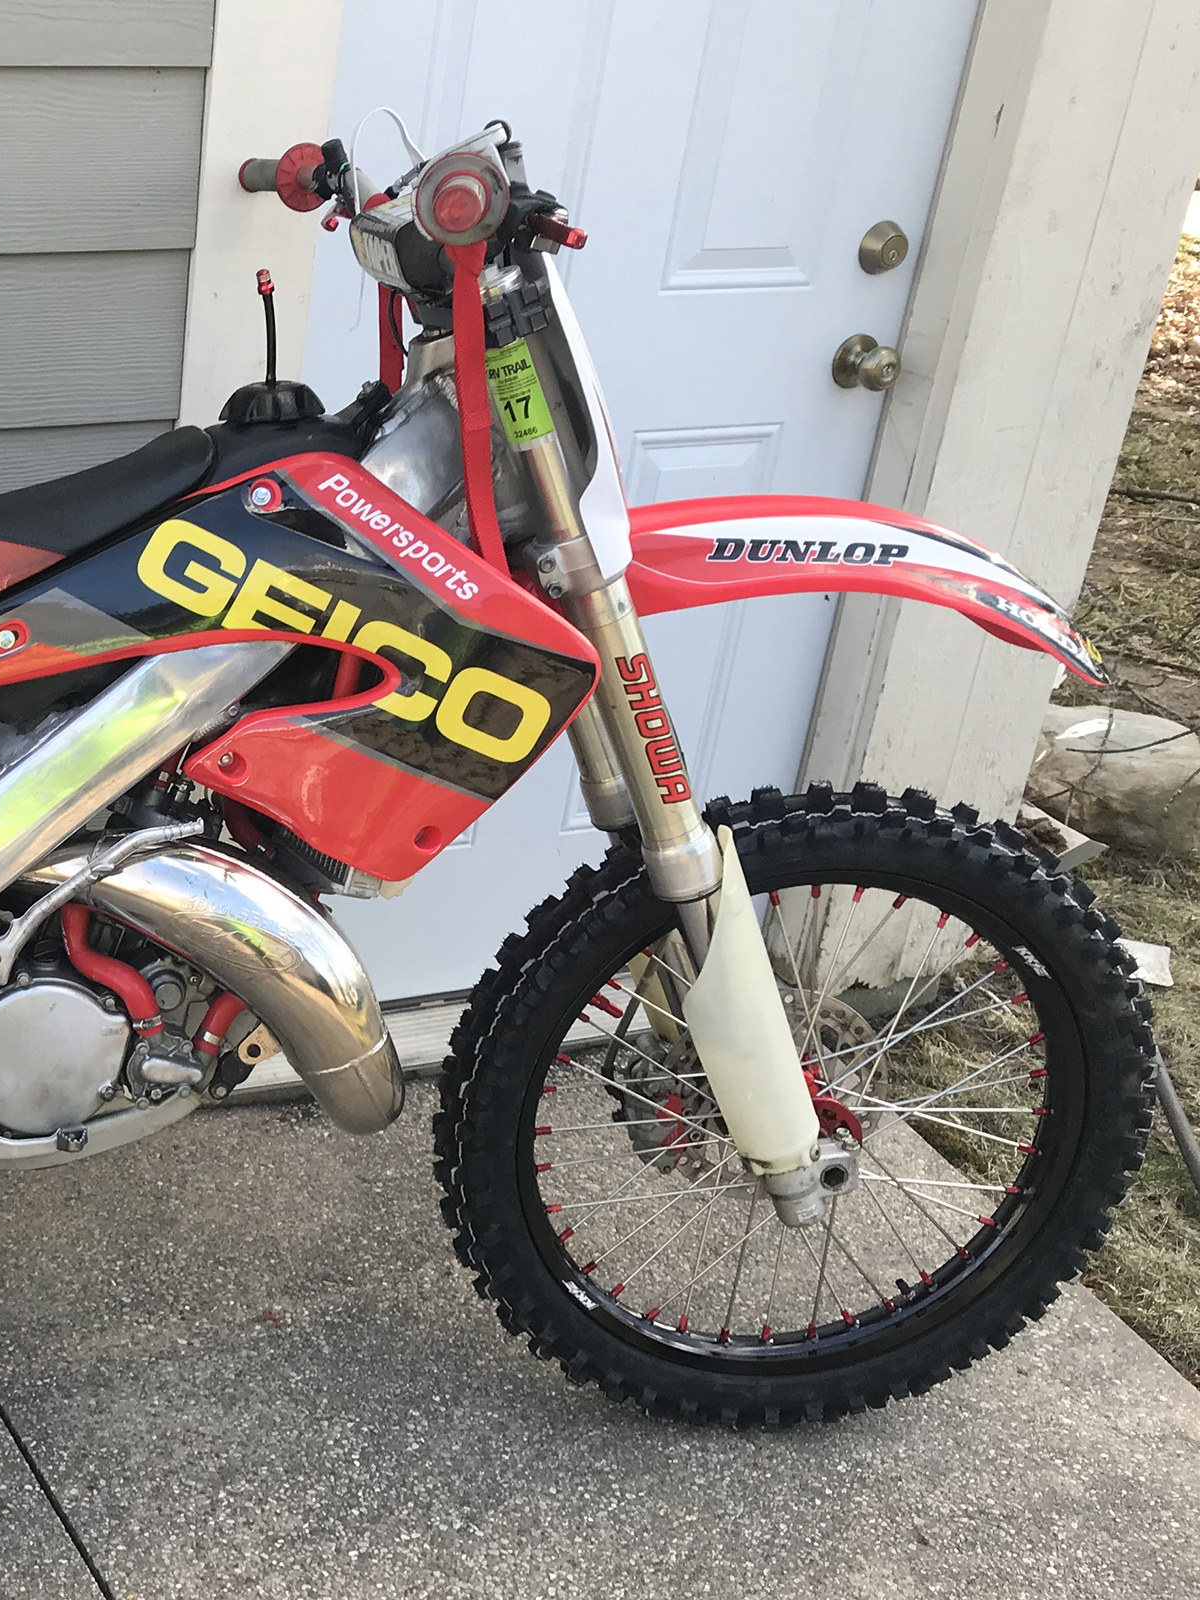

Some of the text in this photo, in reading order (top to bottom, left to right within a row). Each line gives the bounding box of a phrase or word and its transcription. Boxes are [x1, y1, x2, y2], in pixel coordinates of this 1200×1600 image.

[485, 359, 531, 379] RV TRAIL
[504, 395, 531, 422] 17
[317, 471, 481, 602] Powersports
[706, 536, 910, 567] DUNLOP
[137, 518, 552, 763] GEICO
[614, 651, 692, 806] SHOWA
